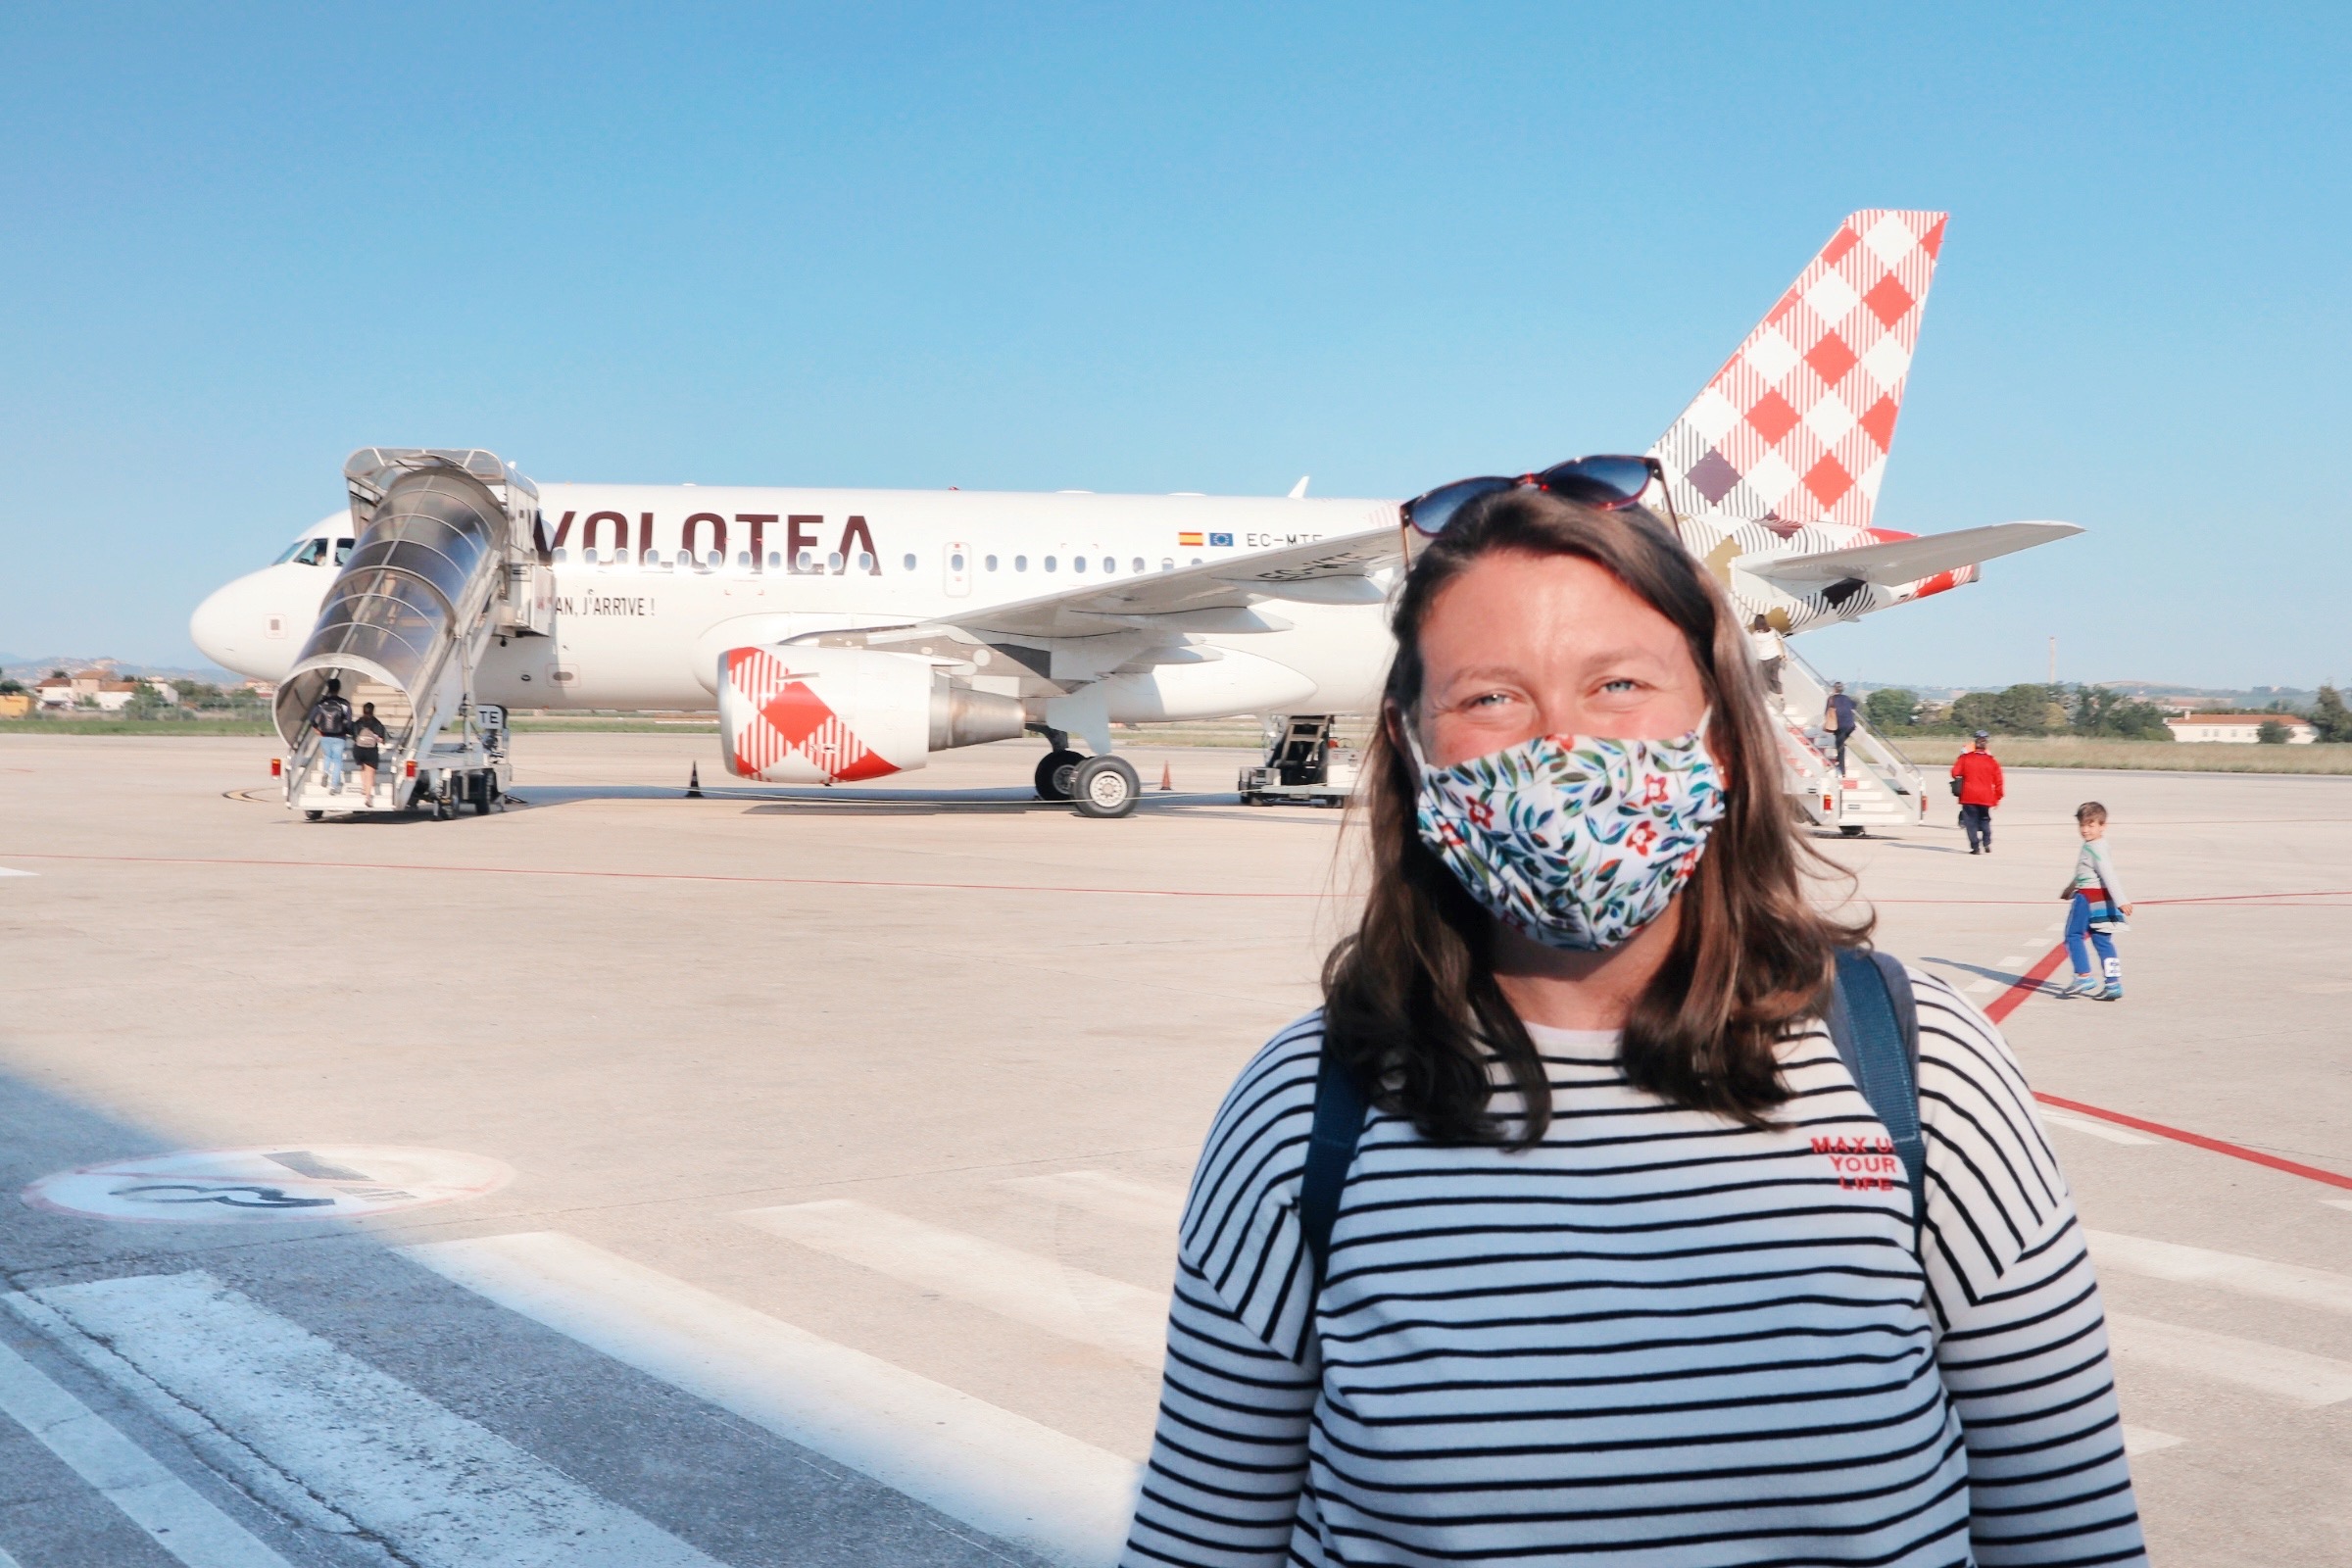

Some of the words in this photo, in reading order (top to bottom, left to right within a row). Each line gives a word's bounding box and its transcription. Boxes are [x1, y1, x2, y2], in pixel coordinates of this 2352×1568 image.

[533, 511, 882, 576] VOLOTEA
[554, 597, 578, 617] AN,
[582, 596, 645, 616] J'ARRIVE
[479, 710, 500, 724] TE
[1811, 1136, 1867, 1153] MAX
[1876, 1137, 1895, 1153] U
[1829, 1155, 1897, 1173] YOUR
[1839, 1176, 1894, 1192] LIFE
